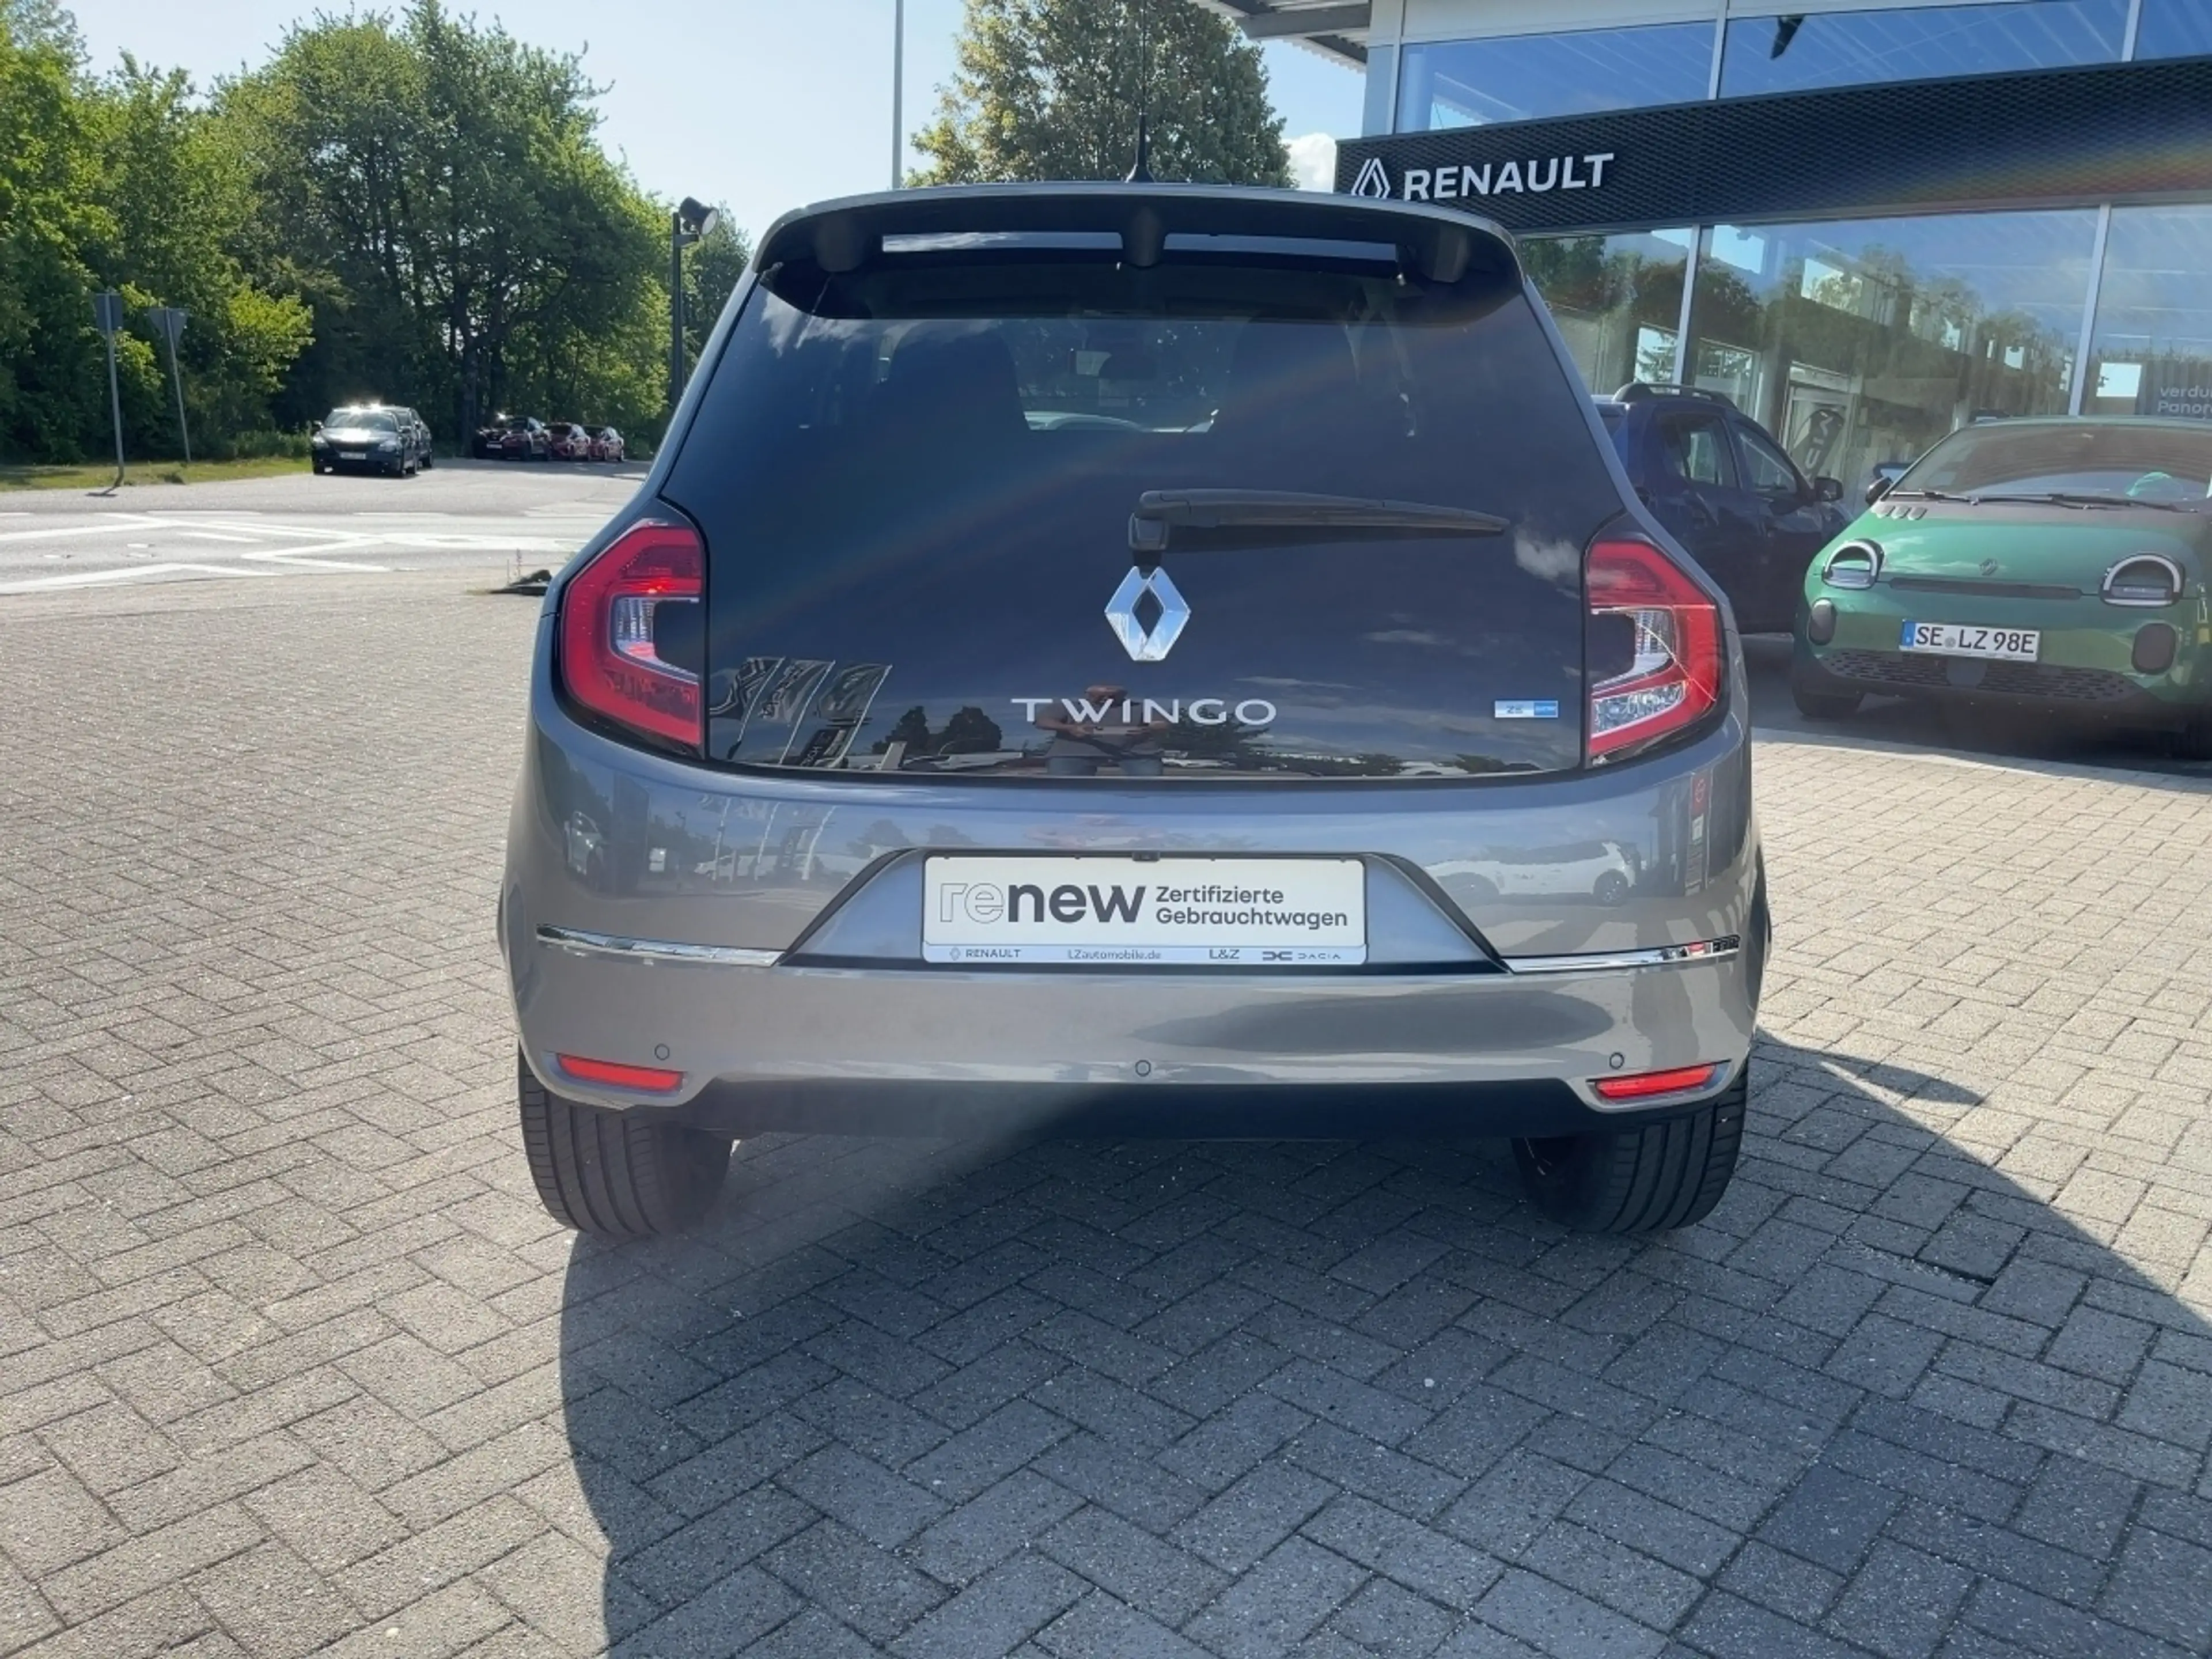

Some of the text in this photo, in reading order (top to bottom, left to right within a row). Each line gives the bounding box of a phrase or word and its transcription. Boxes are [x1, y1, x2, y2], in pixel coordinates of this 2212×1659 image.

[1403, 152, 1614, 202] RENAULT
[2160, 384, 2212, 399] verdu
[2157, 400, 2212, 415] Panor
[1915, 626, 2036, 654] SE LZ 98E
[1010, 698, 1277, 726] TWINGO
[940, 882, 1147, 924] renew
[1155, 884, 1284, 904] Zertifizierte
[1155, 906, 1348, 931] Gebrauchtwagen
[965, 948, 1022, 958] RENAULT
[1067, 949, 1162, 960] LZautomobile.de
[1209, 949, 1240, 960] L&Z
